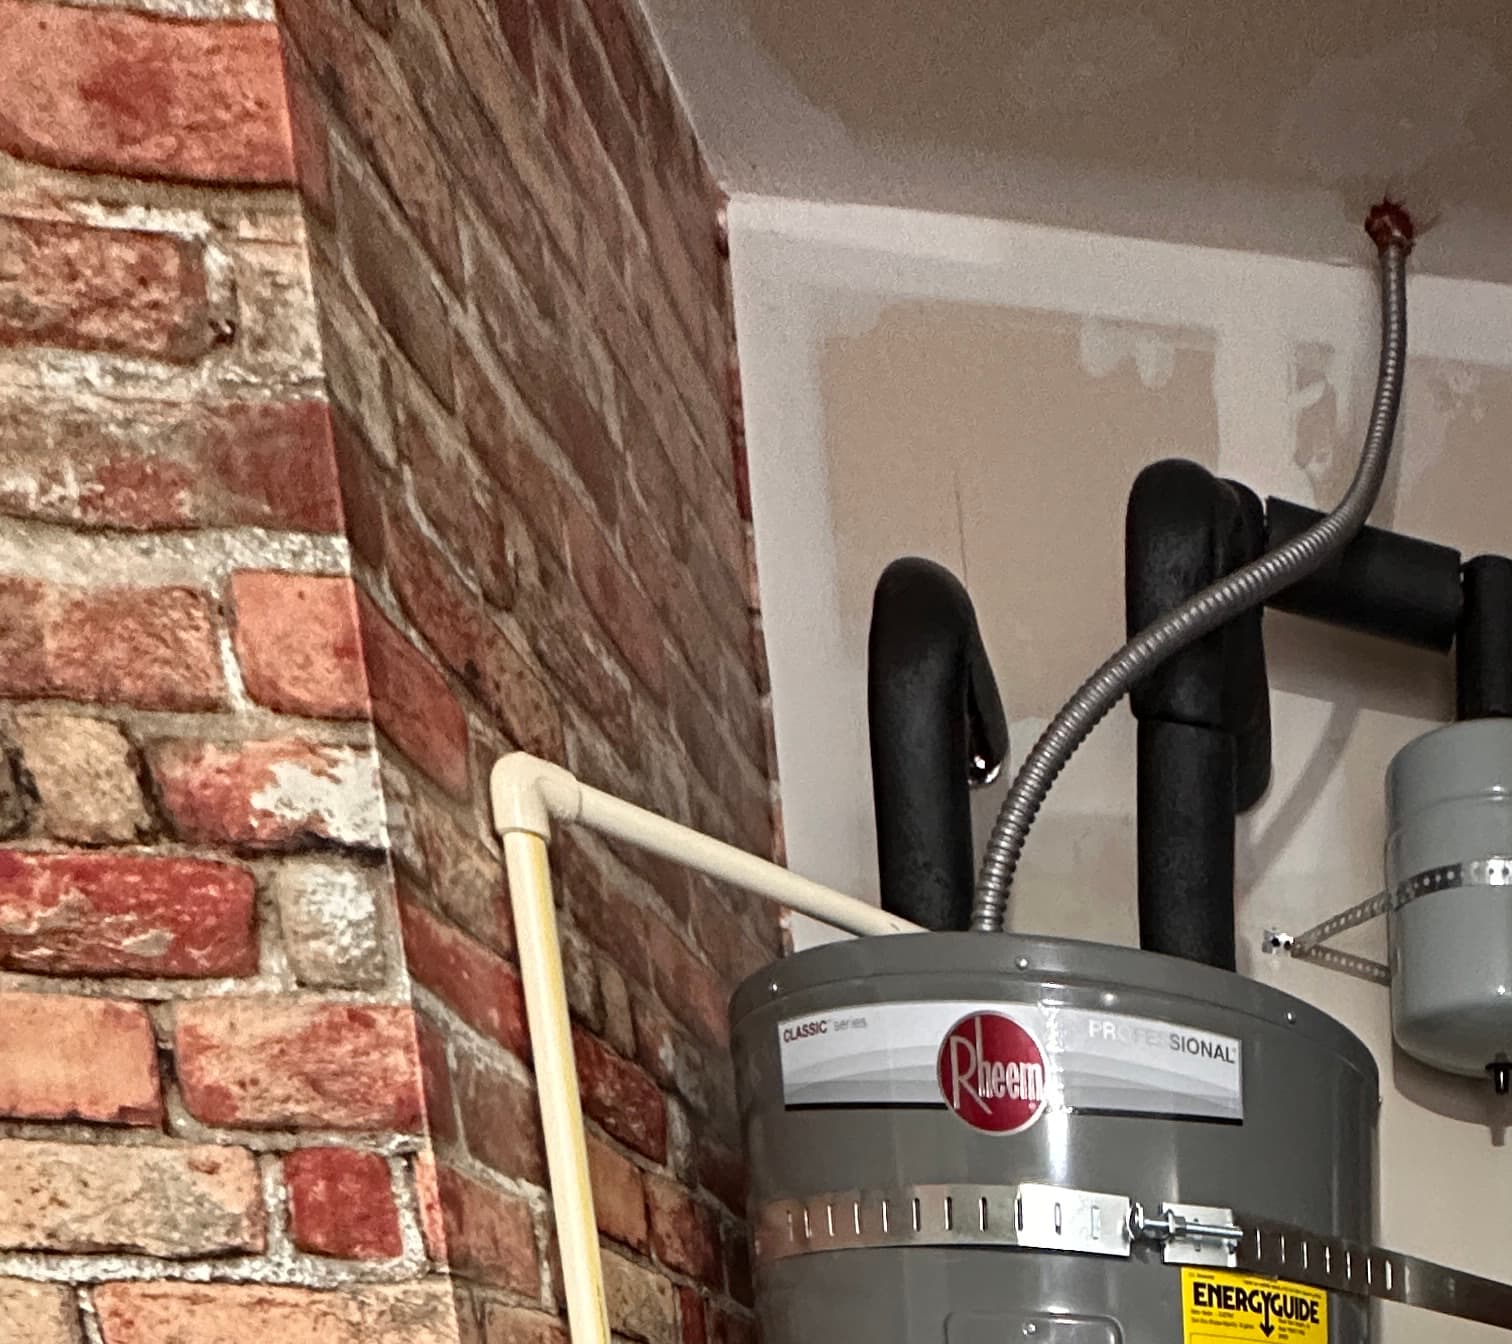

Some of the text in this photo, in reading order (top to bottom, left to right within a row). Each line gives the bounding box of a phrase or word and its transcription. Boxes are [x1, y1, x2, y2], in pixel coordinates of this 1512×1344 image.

[783, 1020, 828, 1042] CLASSIC
[1088, 1018, 1235, 1064] PROFESIONAL
[949, 1015, 1042, 1115] Rheem
[1193, 1281, 1320, 1325] ENERGYGUIDE
